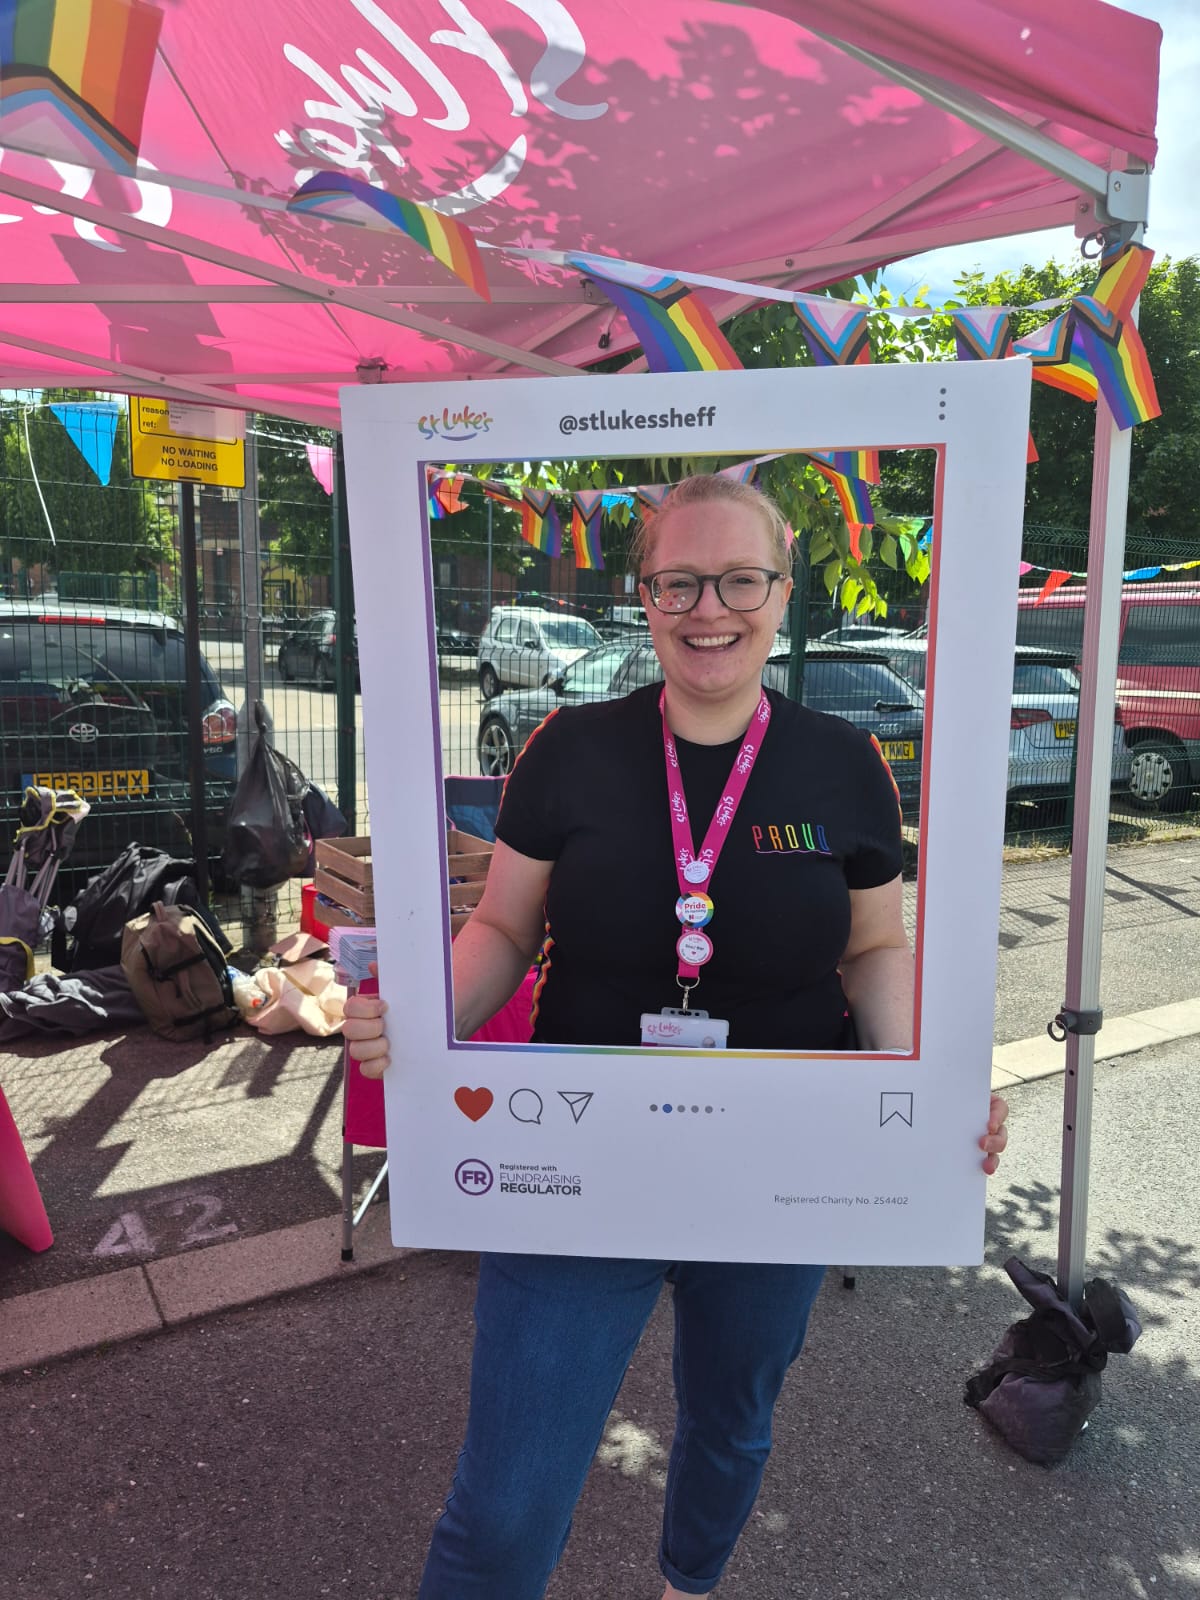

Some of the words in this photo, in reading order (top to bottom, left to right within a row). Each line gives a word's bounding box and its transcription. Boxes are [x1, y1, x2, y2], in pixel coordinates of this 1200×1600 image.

[418, 414, 440, 440] St
[443, 405, 494, 433] Luke's
[558, 406, 716, 436] @stlukessheff
[162, 446, 176, 455] NO
[178, 448, 217, 460] WAITING
[161, 458, 175, 467] NO
[177, 460, 218, 472] LOADING
[743, 744, 754, 755] St
[722, 796, 734, 806] St
[676, 812, 686, 823] St
[751, 823, 830, 851] PROUD
[684, 901, 706, 910] Pride
[500, 1163, 539, 1172] Registered
[461, 1170, 487, 1185] FR
[500, 1172, 582, 1185] FUNDRAISING
[500, 1183, 582, 1196] REGULATOR
[774, 1194, 820, 1206] Registered
[821, 1195, 854, 1207] Charity
[855, 1196, 872, 1205] No.
[873, 1196, 909, 1205] 254402
